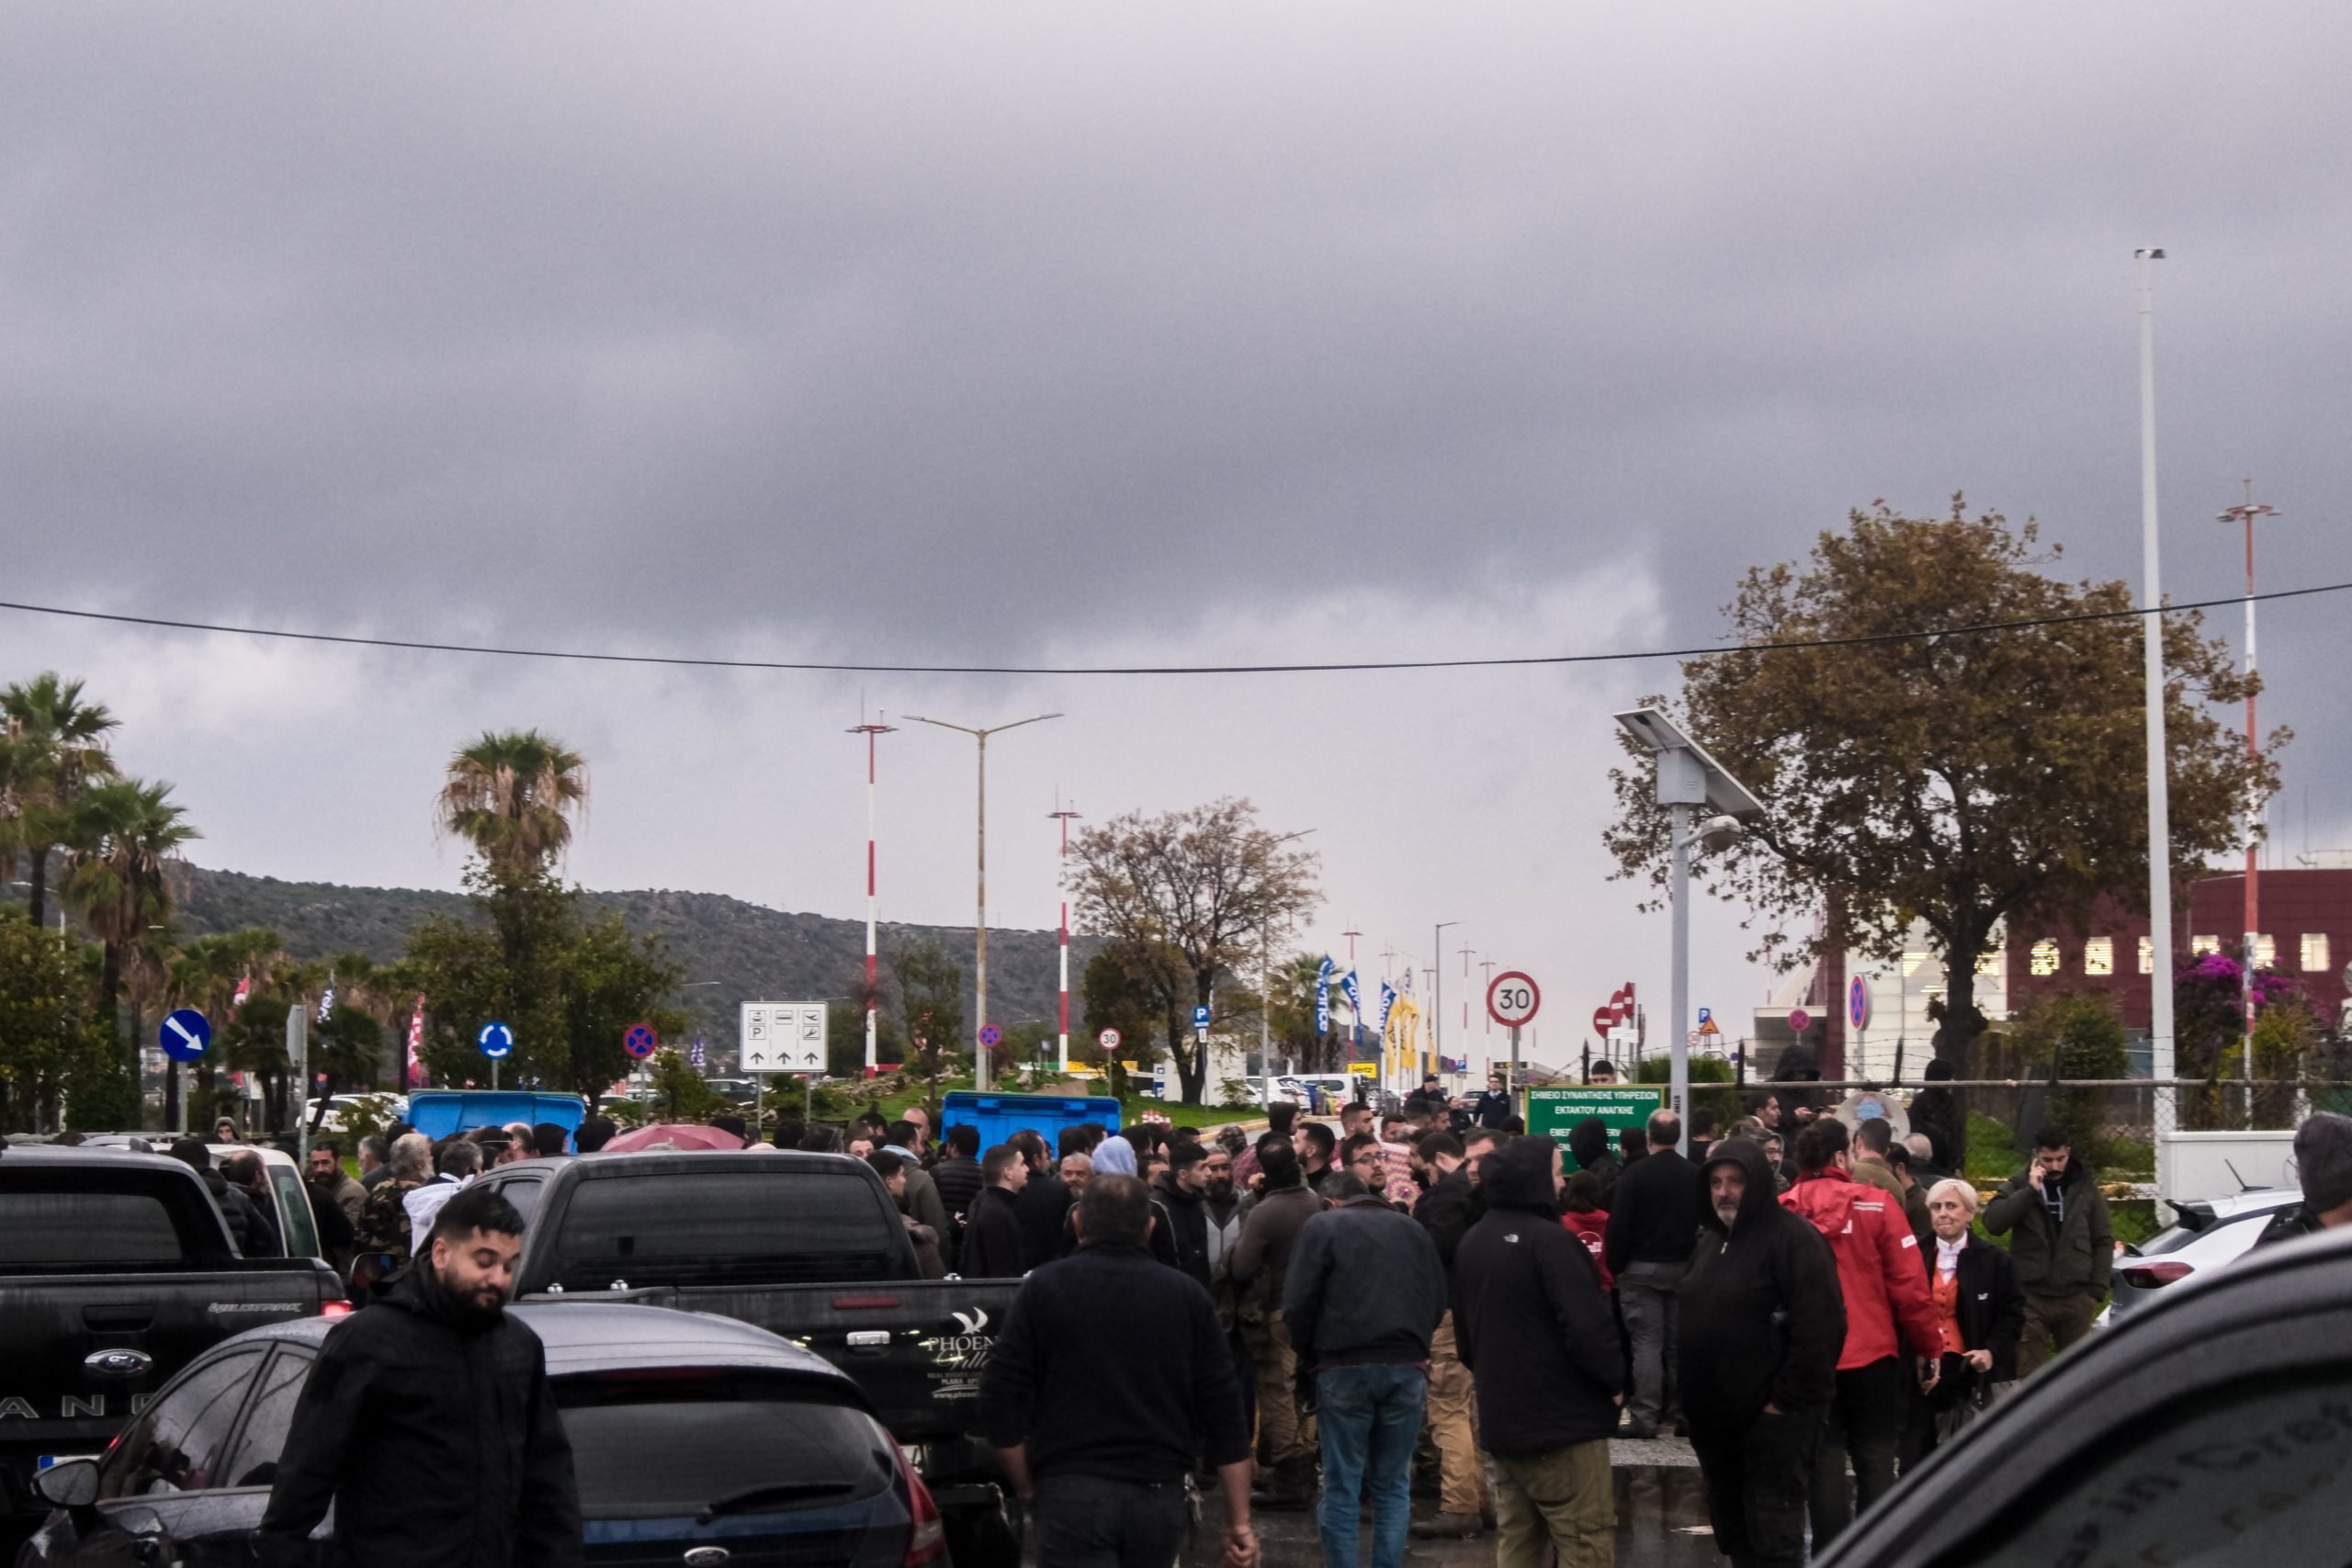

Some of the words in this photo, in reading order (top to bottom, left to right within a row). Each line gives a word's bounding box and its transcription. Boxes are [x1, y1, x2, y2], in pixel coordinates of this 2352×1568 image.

[1499, 989, 1530, 1010] 30
[1196, 1008, 1206, 1020] P
[752, 1028, 762, 1038] P
[1103, 1034, 1117, 1044] 30
[927, 1337, 997, 1351] PHOEN
